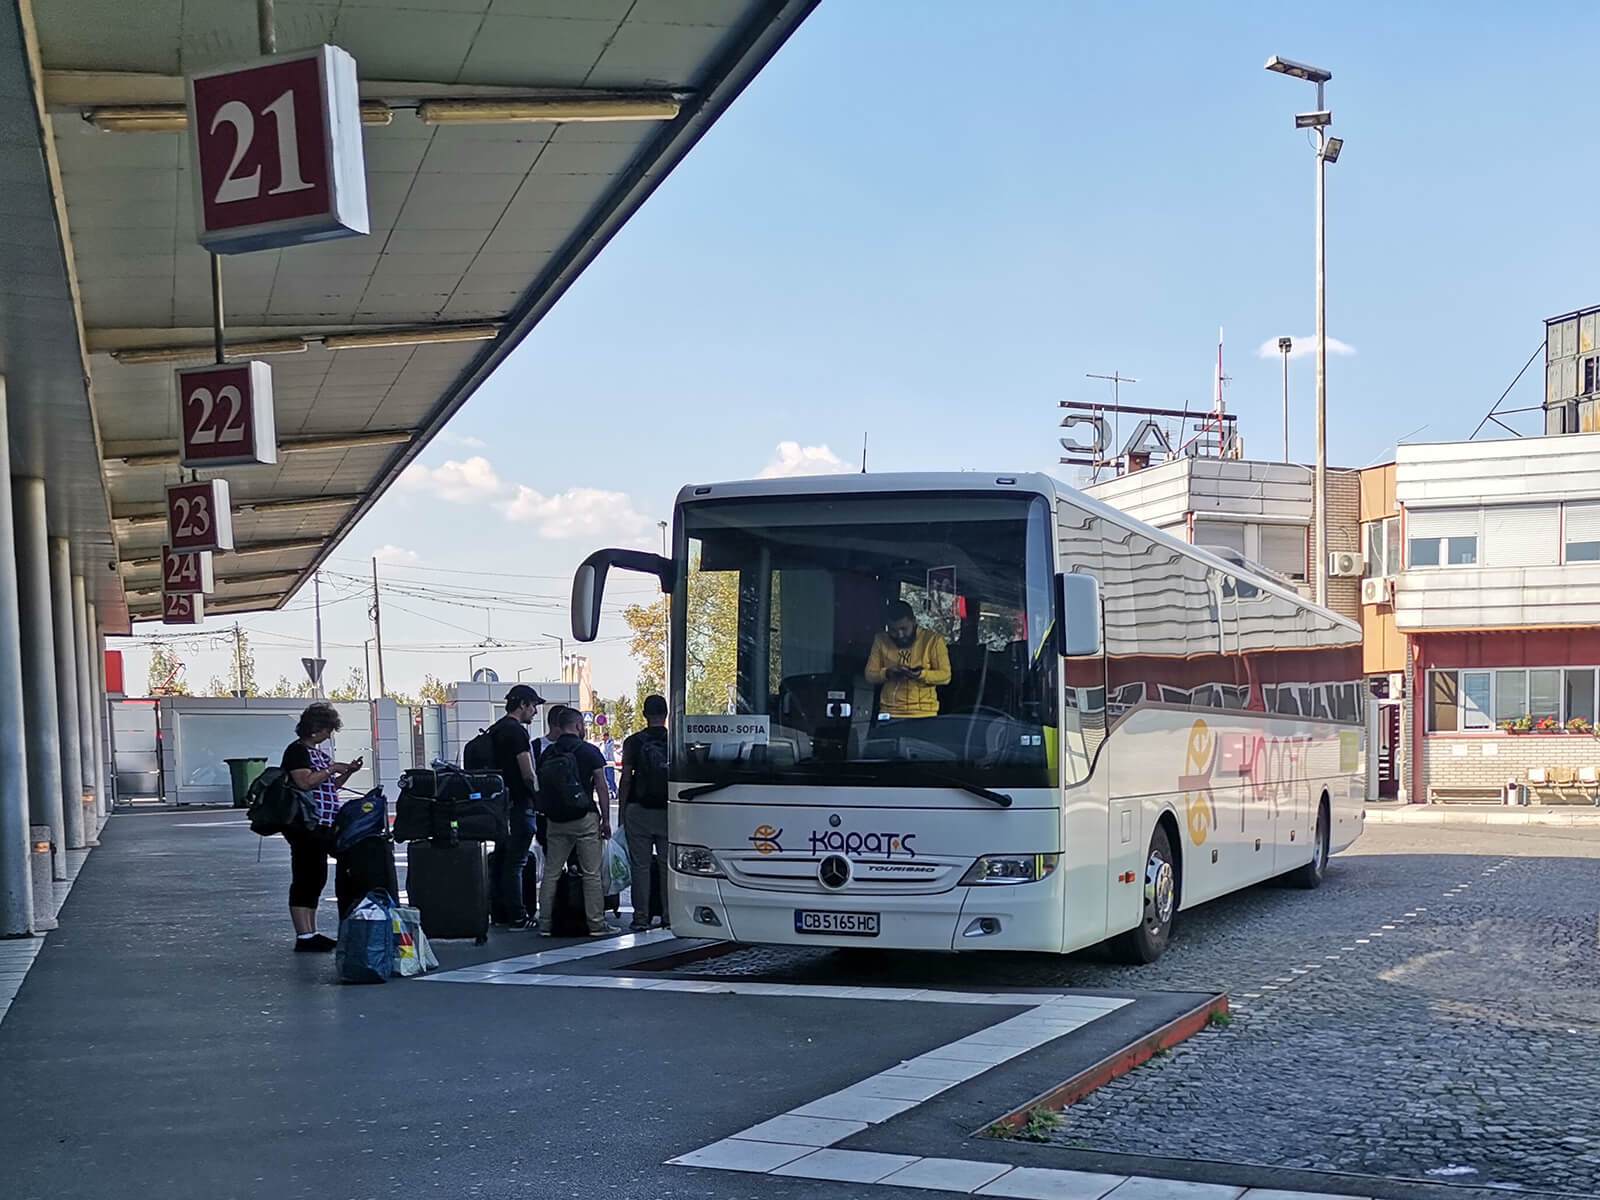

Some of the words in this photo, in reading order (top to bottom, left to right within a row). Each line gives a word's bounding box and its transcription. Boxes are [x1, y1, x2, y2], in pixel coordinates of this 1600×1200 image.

[209, 89, 315, 204] 21
[187, 385, 247, 445] 22
[174, 495, 210, 538] 23
[166, 552, 197, 584] 24
[167, 594, 191, 616] 25
[686, 724, 729, 734] BEOGRAD
[736, 724, 766, 734] SOFIA
[868, 865, 936, 873] TOURISMO
